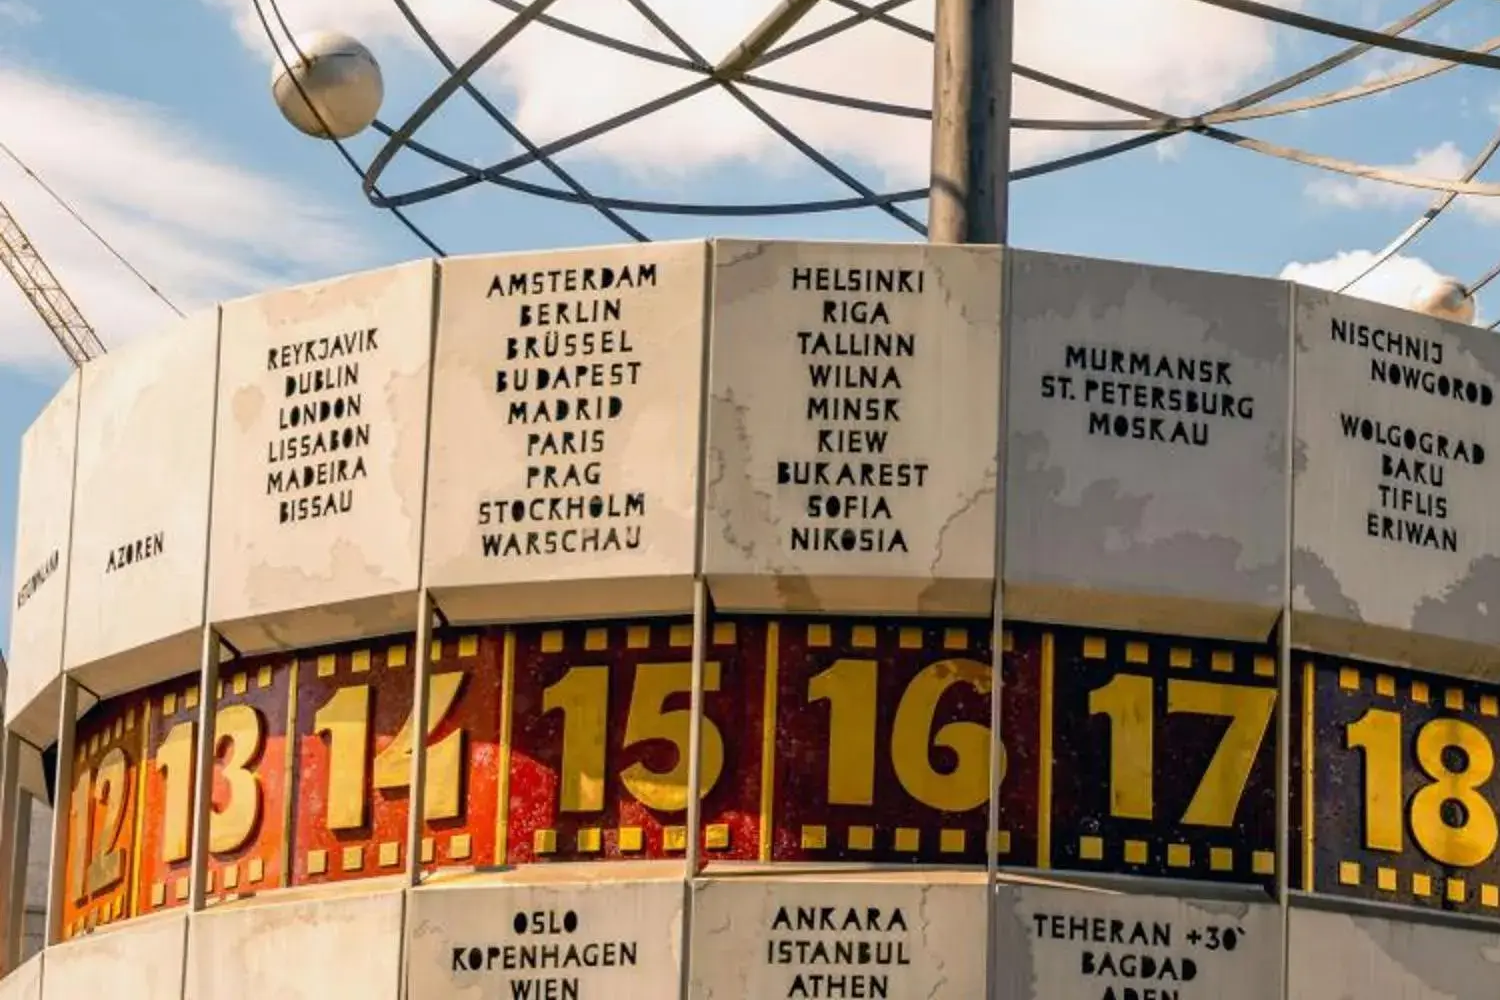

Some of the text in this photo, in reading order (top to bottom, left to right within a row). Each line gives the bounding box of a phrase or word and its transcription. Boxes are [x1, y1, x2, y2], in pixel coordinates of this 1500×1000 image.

[487, 263, 657, 298] AMSTERDAM
[792, 267, 924, 294] HELSINKI
[519, 298, 621, 327] BERLIN
[823, 300, 890, 325] RIGA
[267, 327, 378, 371] REYKJAVIK
[506, 329, 633, 361] BRÜSSEL
[796, 331, 915, 357] TALLINN
[1331, 317, 1443, 365] NISCHNIJ
[285, 363, 358, 398] DUBLIN
[496, 361, 642, 393] BUDAPEST
[808, 364, 902, 389] WILNA
[1065, 345, 1232, 386] MURMANSK
[1371, 358, 1494, 407] NOWGOROD
[279, 393, 361, 430] LONDON
[507, 395, 623, 425] MADRID
[807, 396, 900, 422] MINSK
[1041, 374, 1254, 420] ST. PETERSBURG
[268, 423, 370, 463] LISSABON
[527, 429, 605, 457] PARIS
[818, 429, 889, 454] KIEW
[1088, 411, 1208, 447] MOSKAU
[1340, 413, 1485, 465] WOLGOGRAD
[267, 456, 367, 495] MADEIRA
[527, 461, 601, 489] PRAG
[777, 461, 929, 487] BUKAREST
[1382, 453, 1443, 488] BAKU
[279, 489, 353, 524] BISSAU
[479, 493, 645, 525] STOCKHOLM
[807, 494, 892, 520] SOFIA
[1378, 484, 1447, 519] TIFLIS
[481, 526, 641, 557] WARSCHAU
[791, 527, 909, 553] NIKOSIA
[1367, 512, 1457, 553] ERIWAN
[106, 531, 164, 573] AZOREN
[315, 671, 464, 830] 14
[543, 660, 723, 812] 15
[807, 657, 1007, 812] 16
[1088, 672, 1278, 826] 17
[154, 703, 266, 863] 13
[1346, 708, 1499, 867] 18
[71, 746, 129, 907] 12
[513, 909, 578, 935] OSLO
[771, 906, 908, 932] ANKARA
[1032, 913, 1171, 947] TEHERAN
[451, 941, 637, 972] KOPENHAGEN
[767, 939, 911, 965] ISTANBUL
[1081, 951, 1198, 982] BAGDAD
[510, 977, 579, 1000] WIEN
[787, 974, 889, 999] ATHEN
